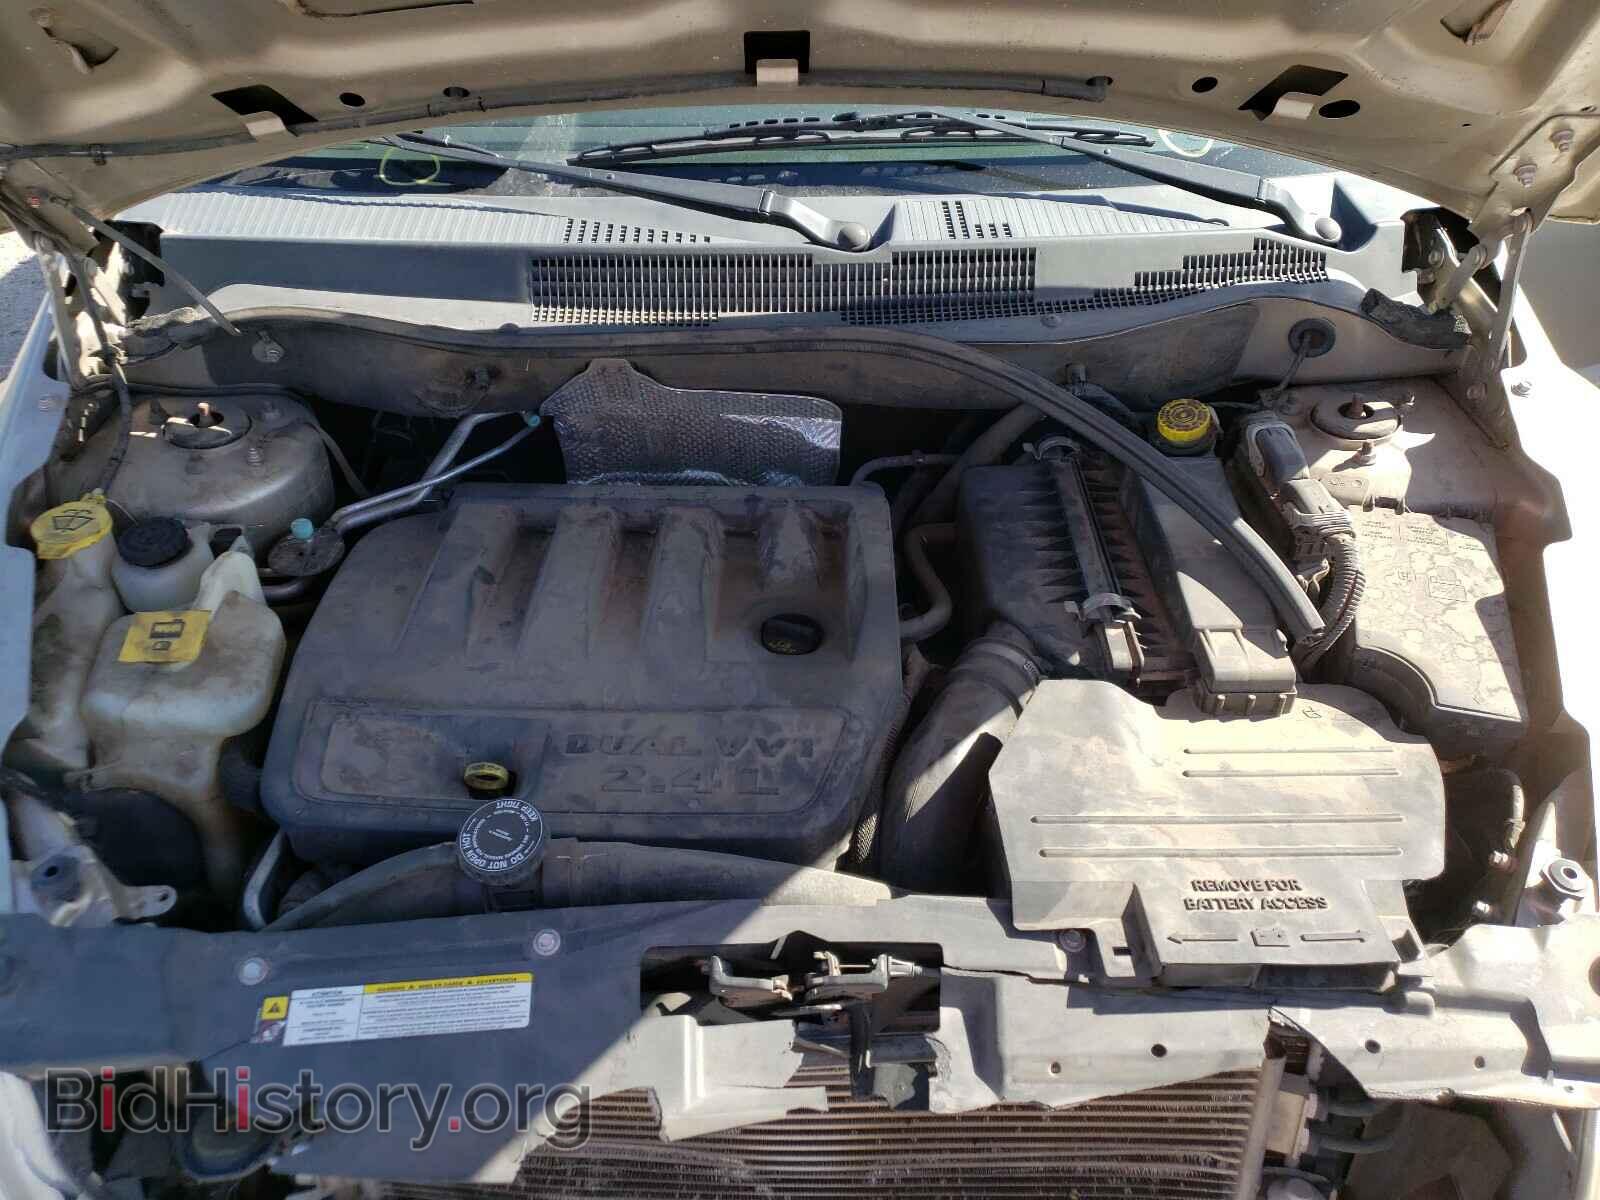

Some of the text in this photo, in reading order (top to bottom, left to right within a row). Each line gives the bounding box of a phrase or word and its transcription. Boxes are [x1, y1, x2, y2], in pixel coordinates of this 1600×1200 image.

[520, 805, 538, 822] KEEP
[462, 832, 524, 869] DO NOT OPEN HOT
[1191, 879, 1303, 892] REMOVE FOR
[1183, 896, 1329, 911] BATTERY ACCESS
